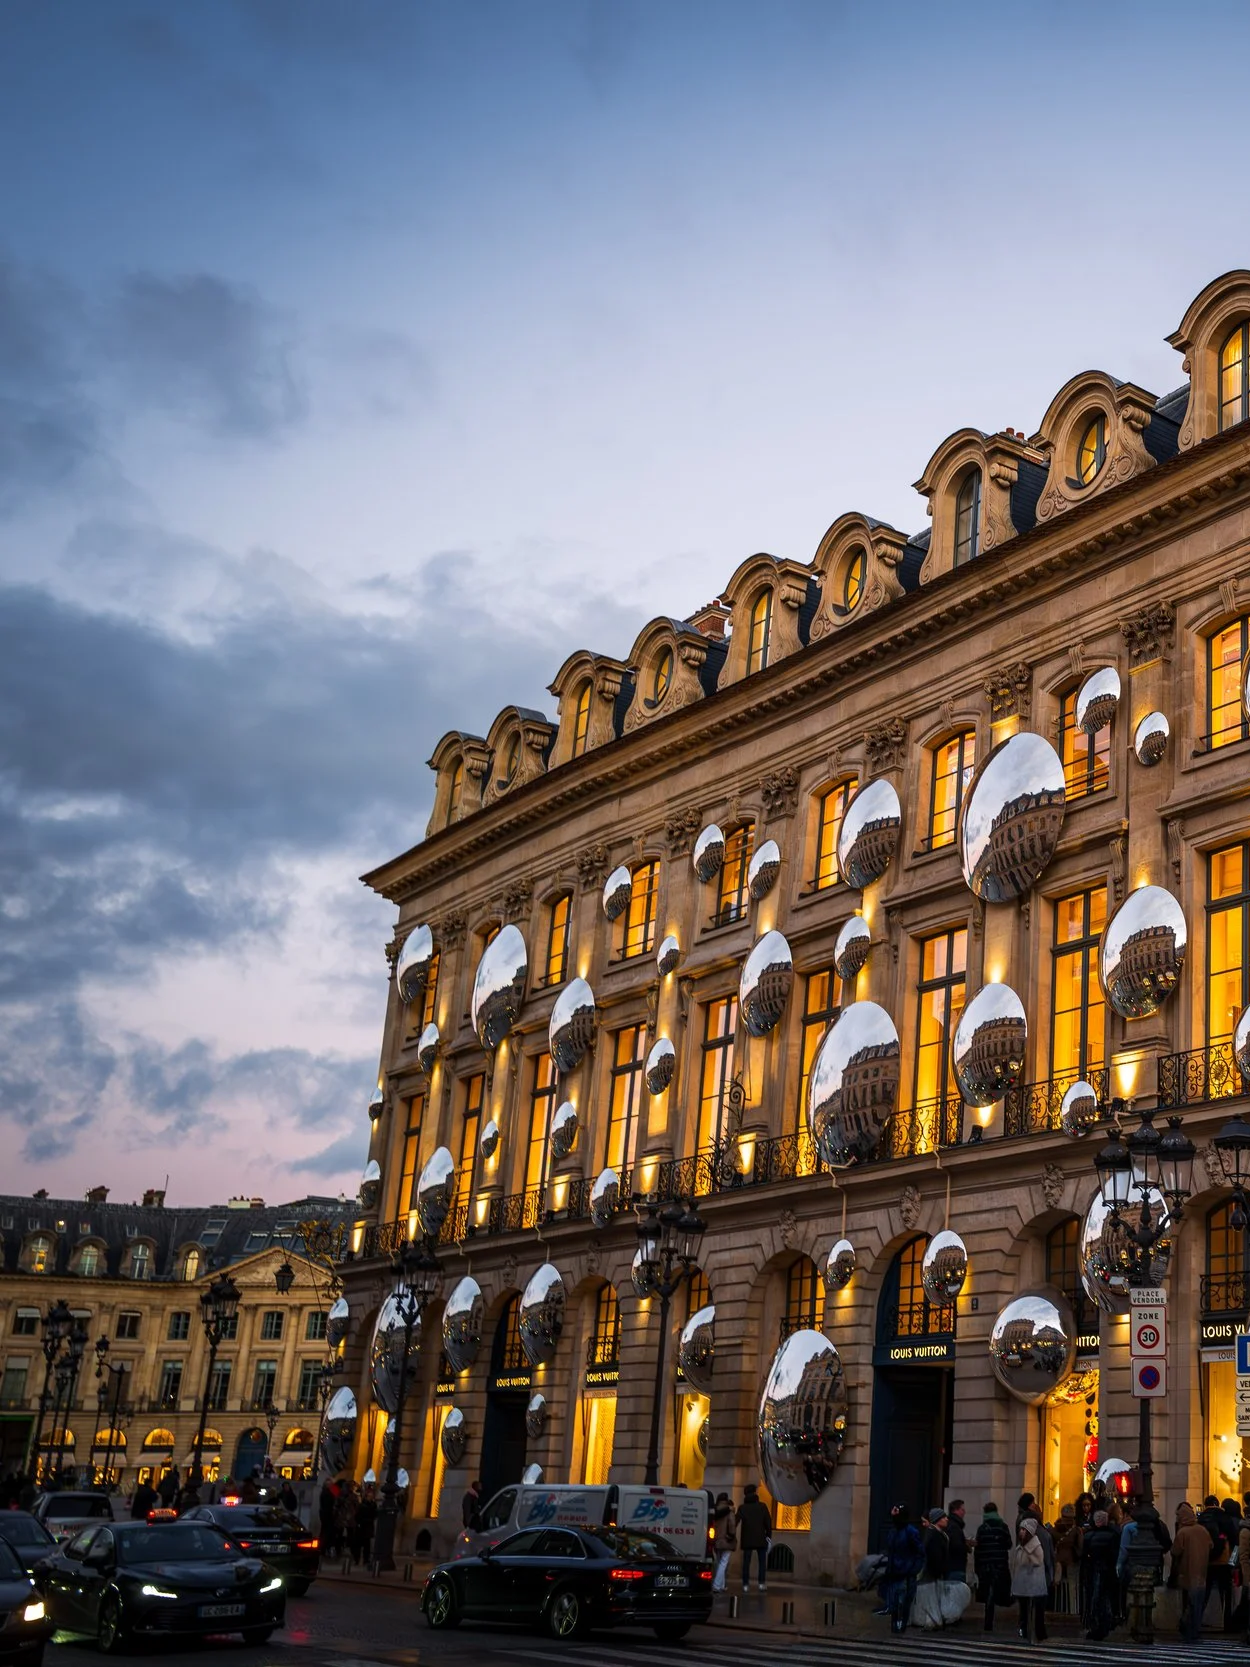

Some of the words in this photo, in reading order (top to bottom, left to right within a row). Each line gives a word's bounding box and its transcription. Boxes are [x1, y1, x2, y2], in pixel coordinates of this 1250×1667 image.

[1137, 1290, 1159, 1298] PLACE
[1137, 1312, 1159, 1320] ZONE
[1142, 1331, 1155, 1342] 30
[1202, 1324, 1232, 1338] LOUIS
[890, 1347, 912, 1361] LOUIS
[914, 1345, 947, 1360] VUITTON
[496, 1378, 510, 1388] LOUIS
[586, 1372, 602, 1383] LOUIS
